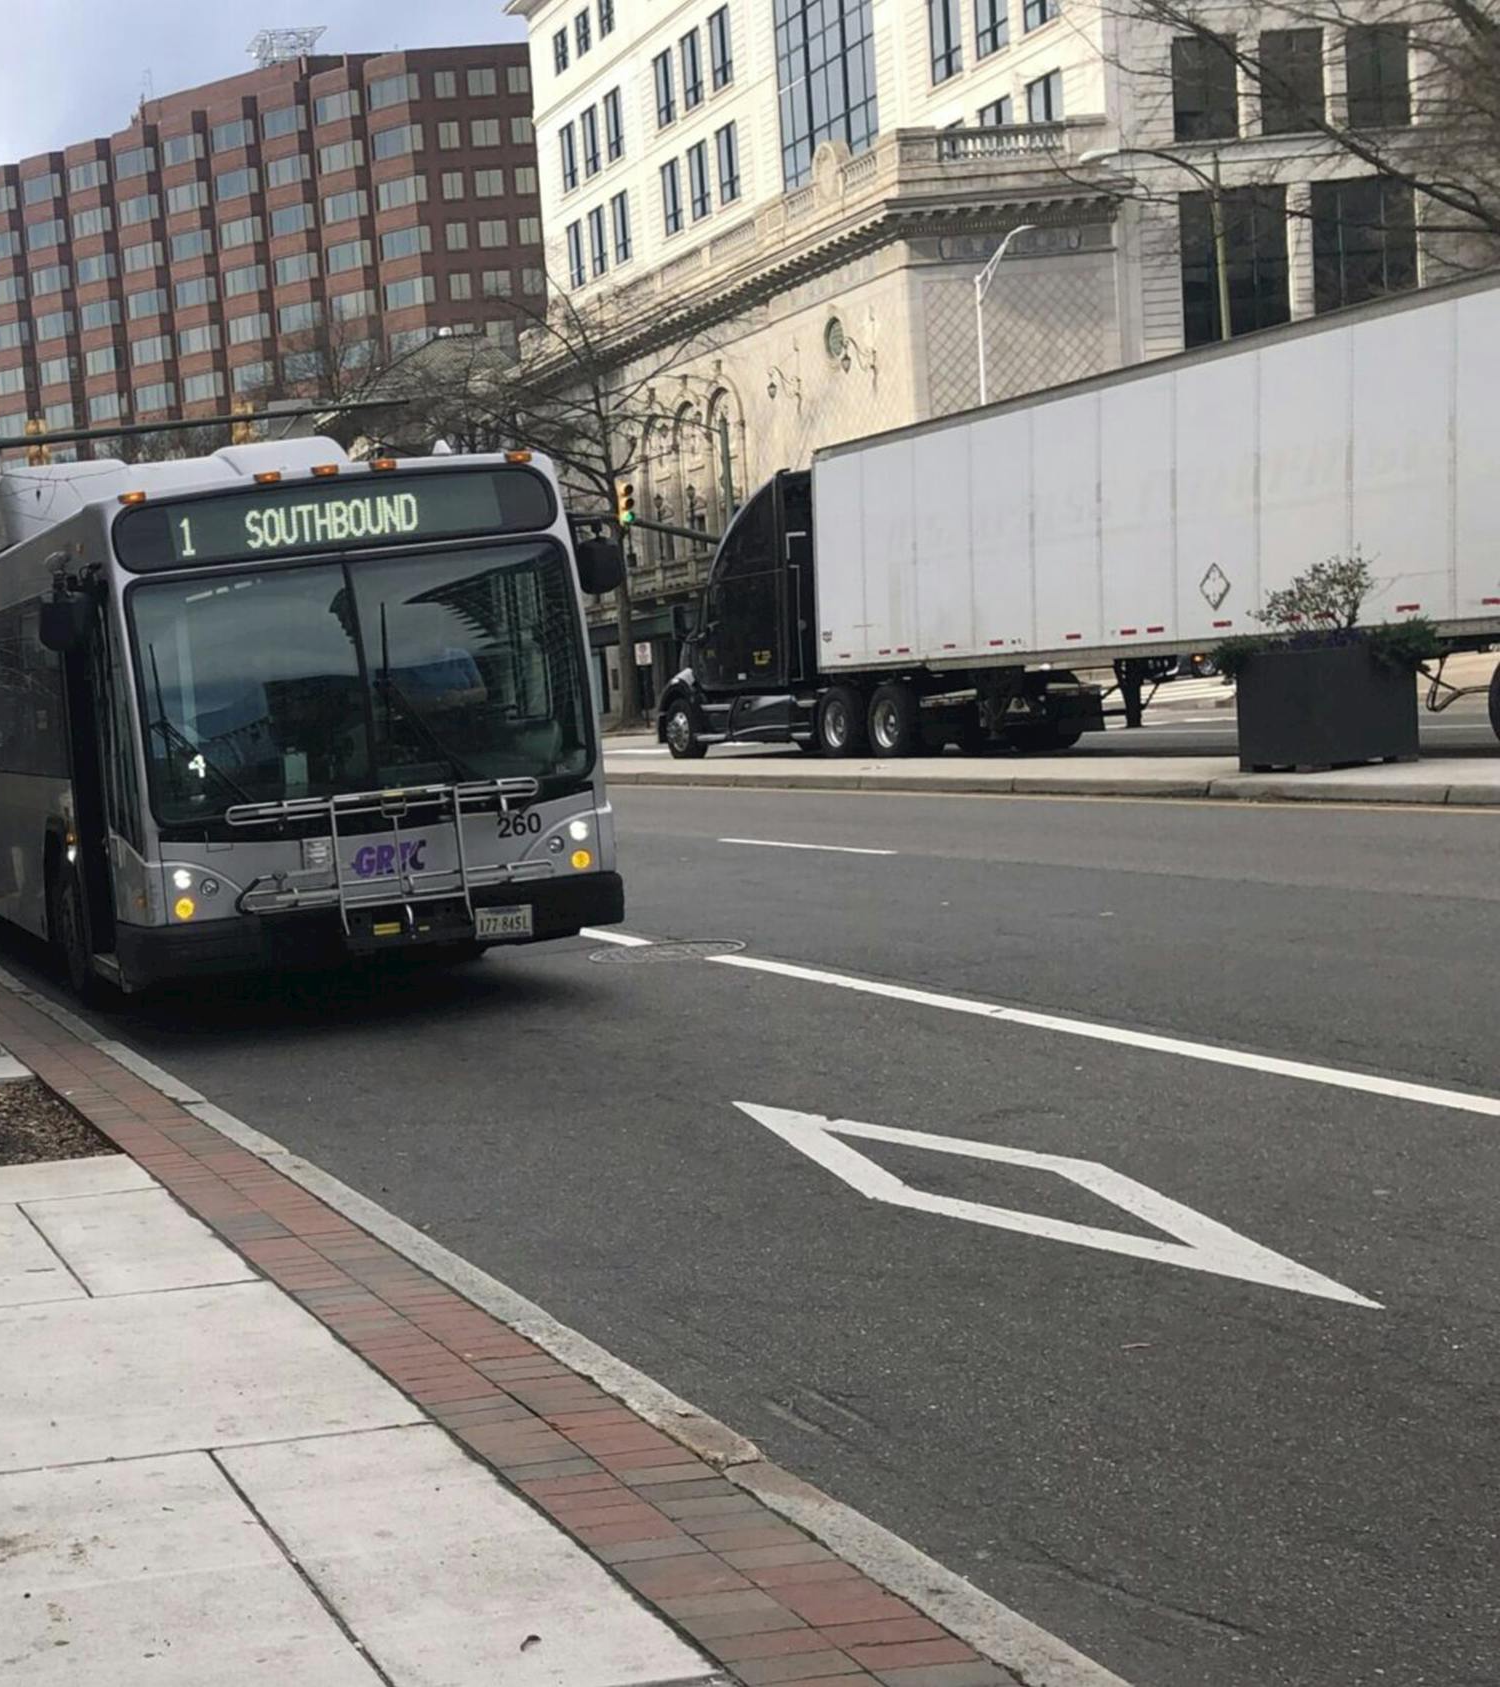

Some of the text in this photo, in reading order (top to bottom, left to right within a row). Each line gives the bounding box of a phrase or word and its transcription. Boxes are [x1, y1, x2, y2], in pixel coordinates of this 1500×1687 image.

[180, 493, 418, 556] 1 SOUTHBOUND
[497, 812, 541, 838] 260
[352, 839, 426, 877] GRTC
